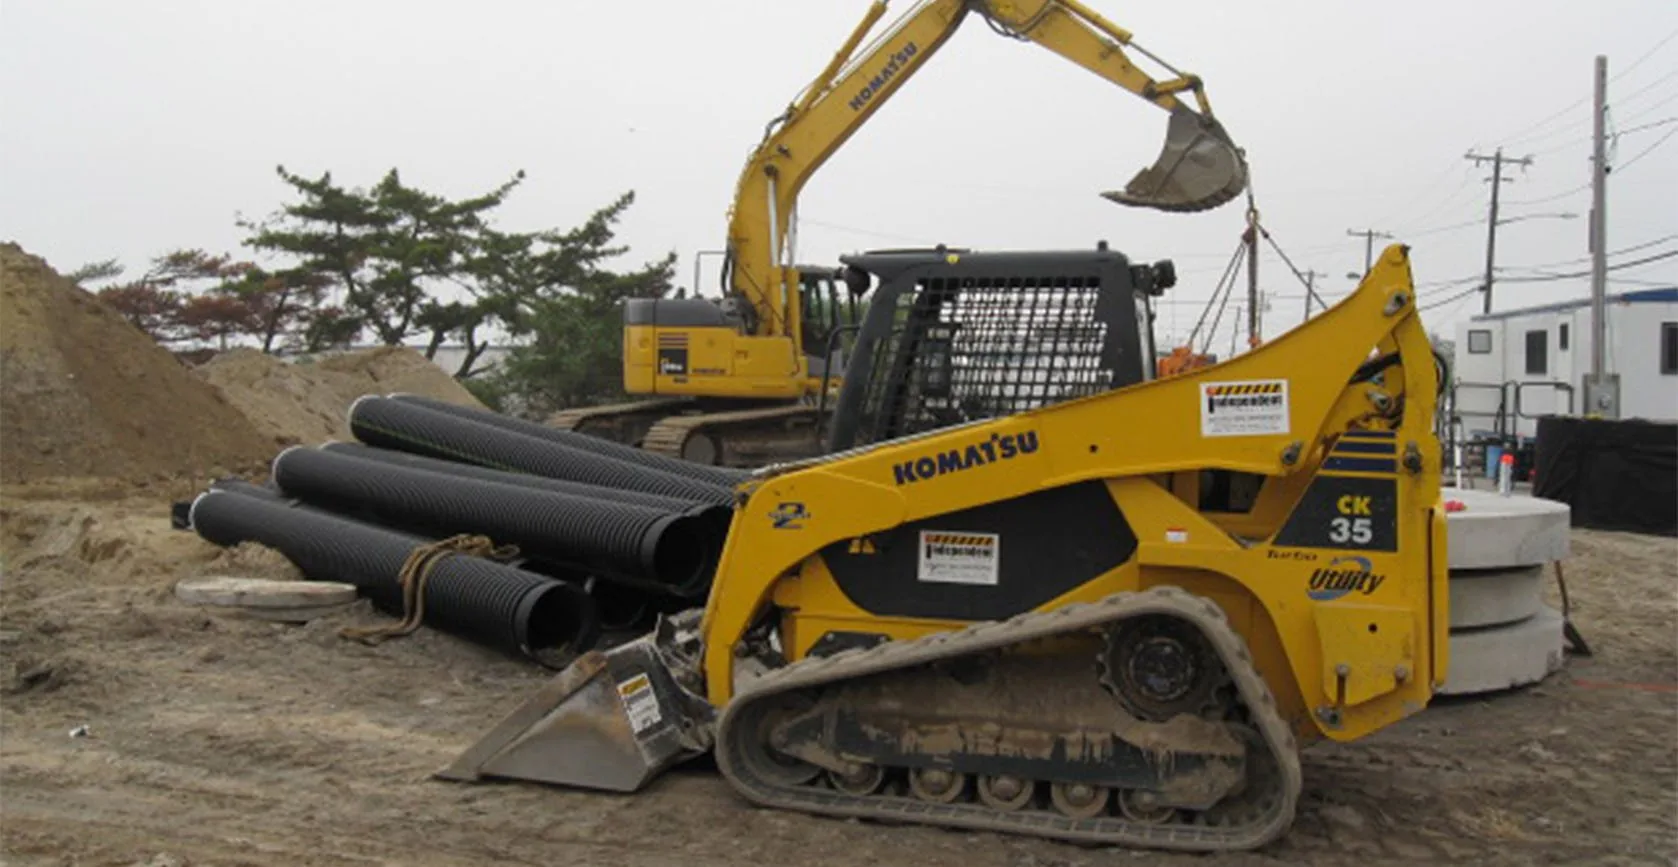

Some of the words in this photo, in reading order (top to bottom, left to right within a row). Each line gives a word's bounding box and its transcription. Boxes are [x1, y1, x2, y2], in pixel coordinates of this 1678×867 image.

[848, 41, 918, 111] KOMATSU
[893, 431, 1039, 485] KOMATSU
[1336, 495, 1372, 516] CK
[1329, 517, 1373, 544] 35
[1309, 567, 1386, 595] Utility
